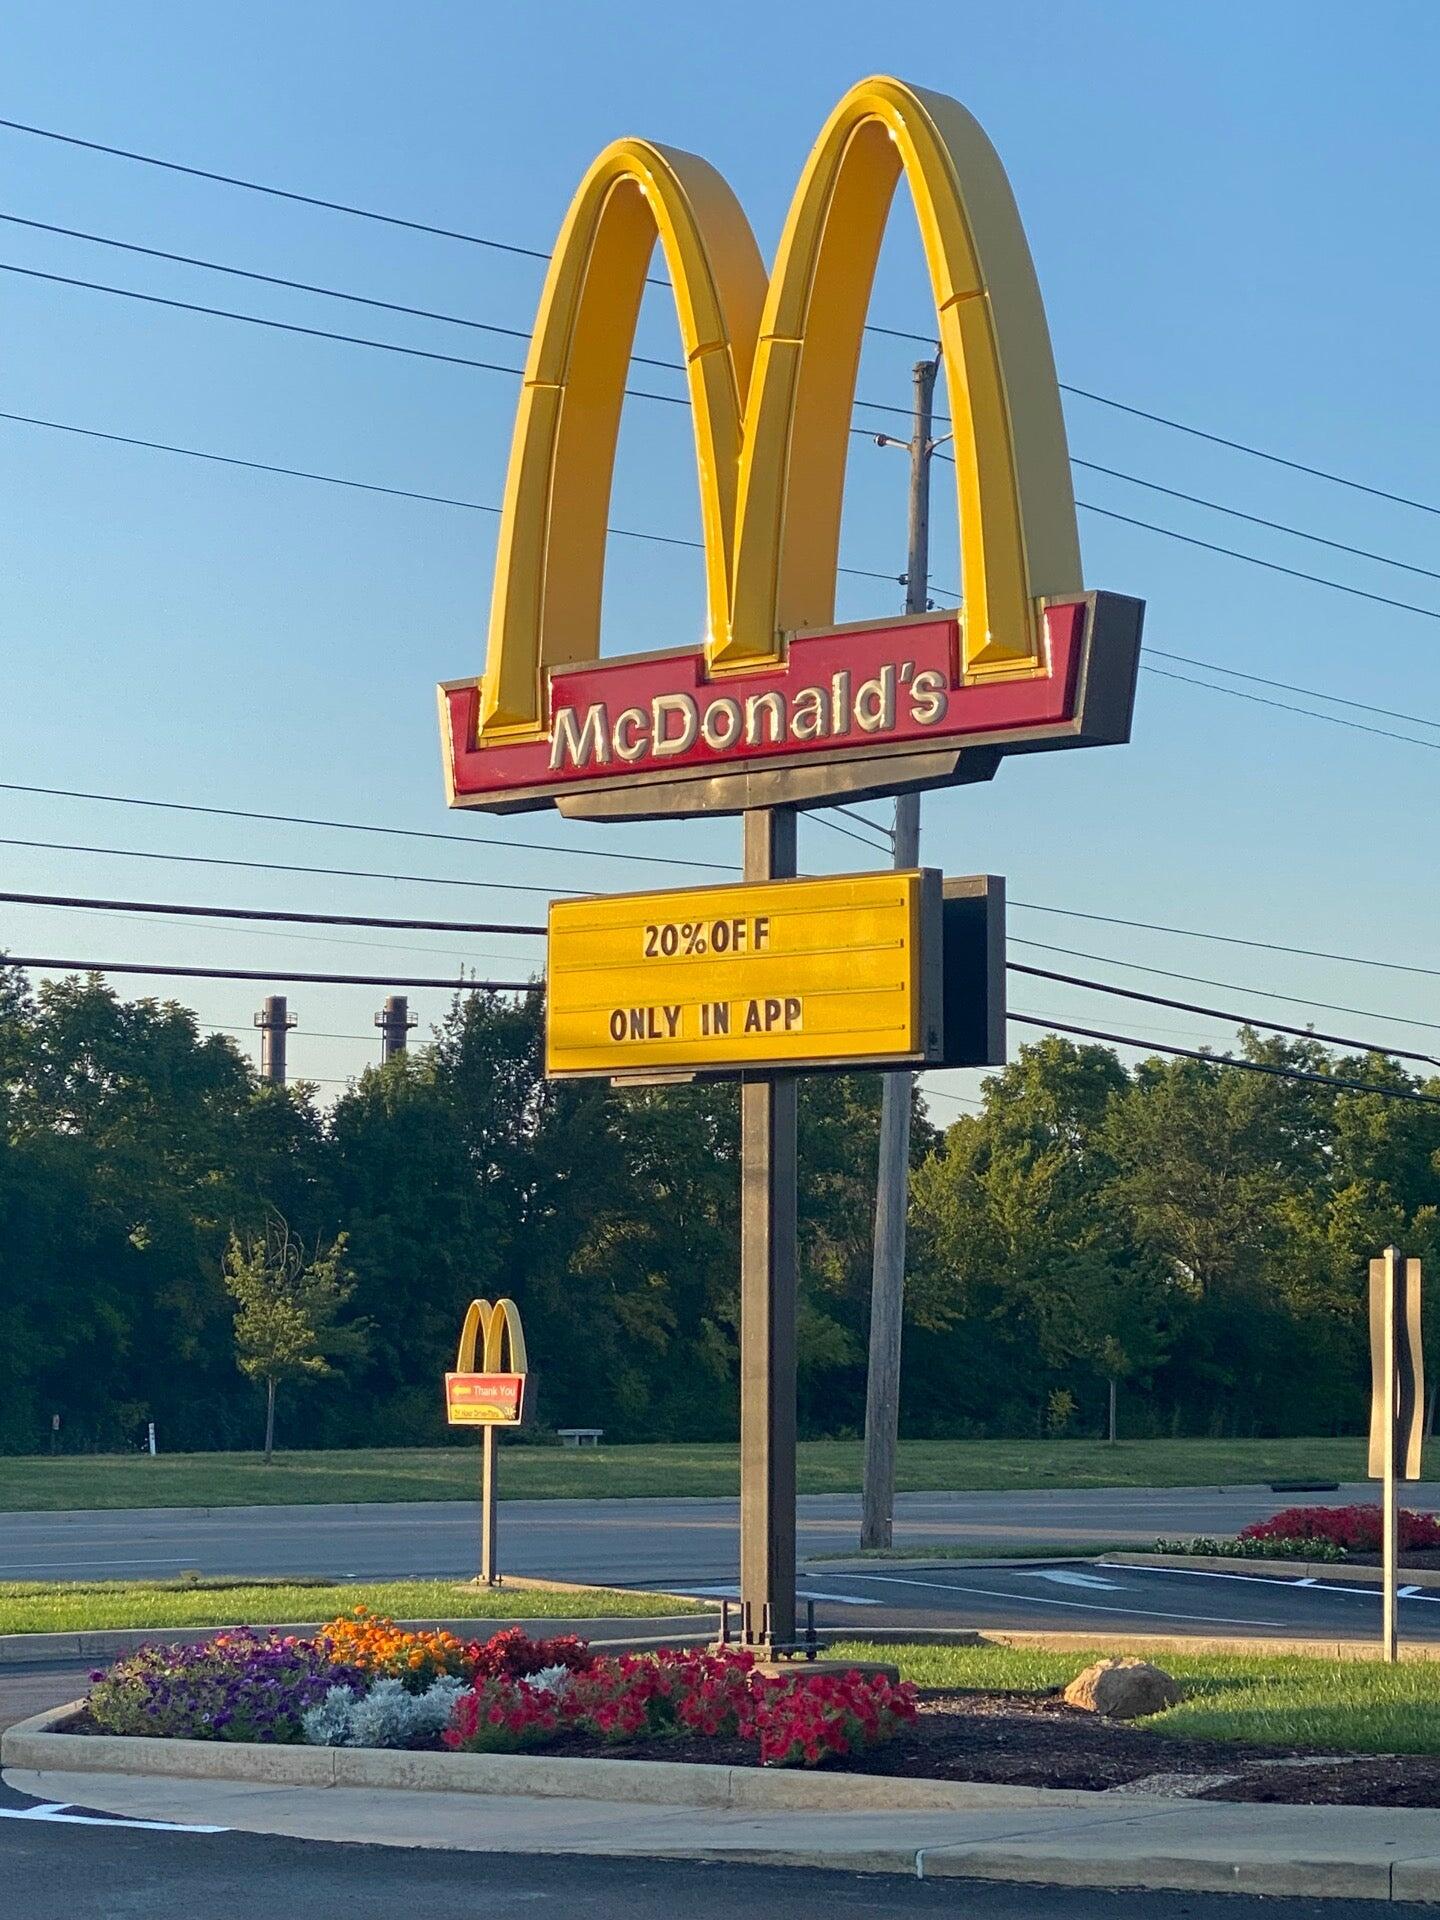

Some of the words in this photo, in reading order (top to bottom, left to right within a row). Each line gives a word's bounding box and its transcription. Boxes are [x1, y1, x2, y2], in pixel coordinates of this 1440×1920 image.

[548, 662, 947, 768] McDonald's
[609, 1005, 682, 1041] ONLY
[701, 1001, 730, 1036] IN
[745, 998, 801, 1032] APP
[474, 1385, 497, 1396] Thank
[500, 1385, 514, 1396] You
